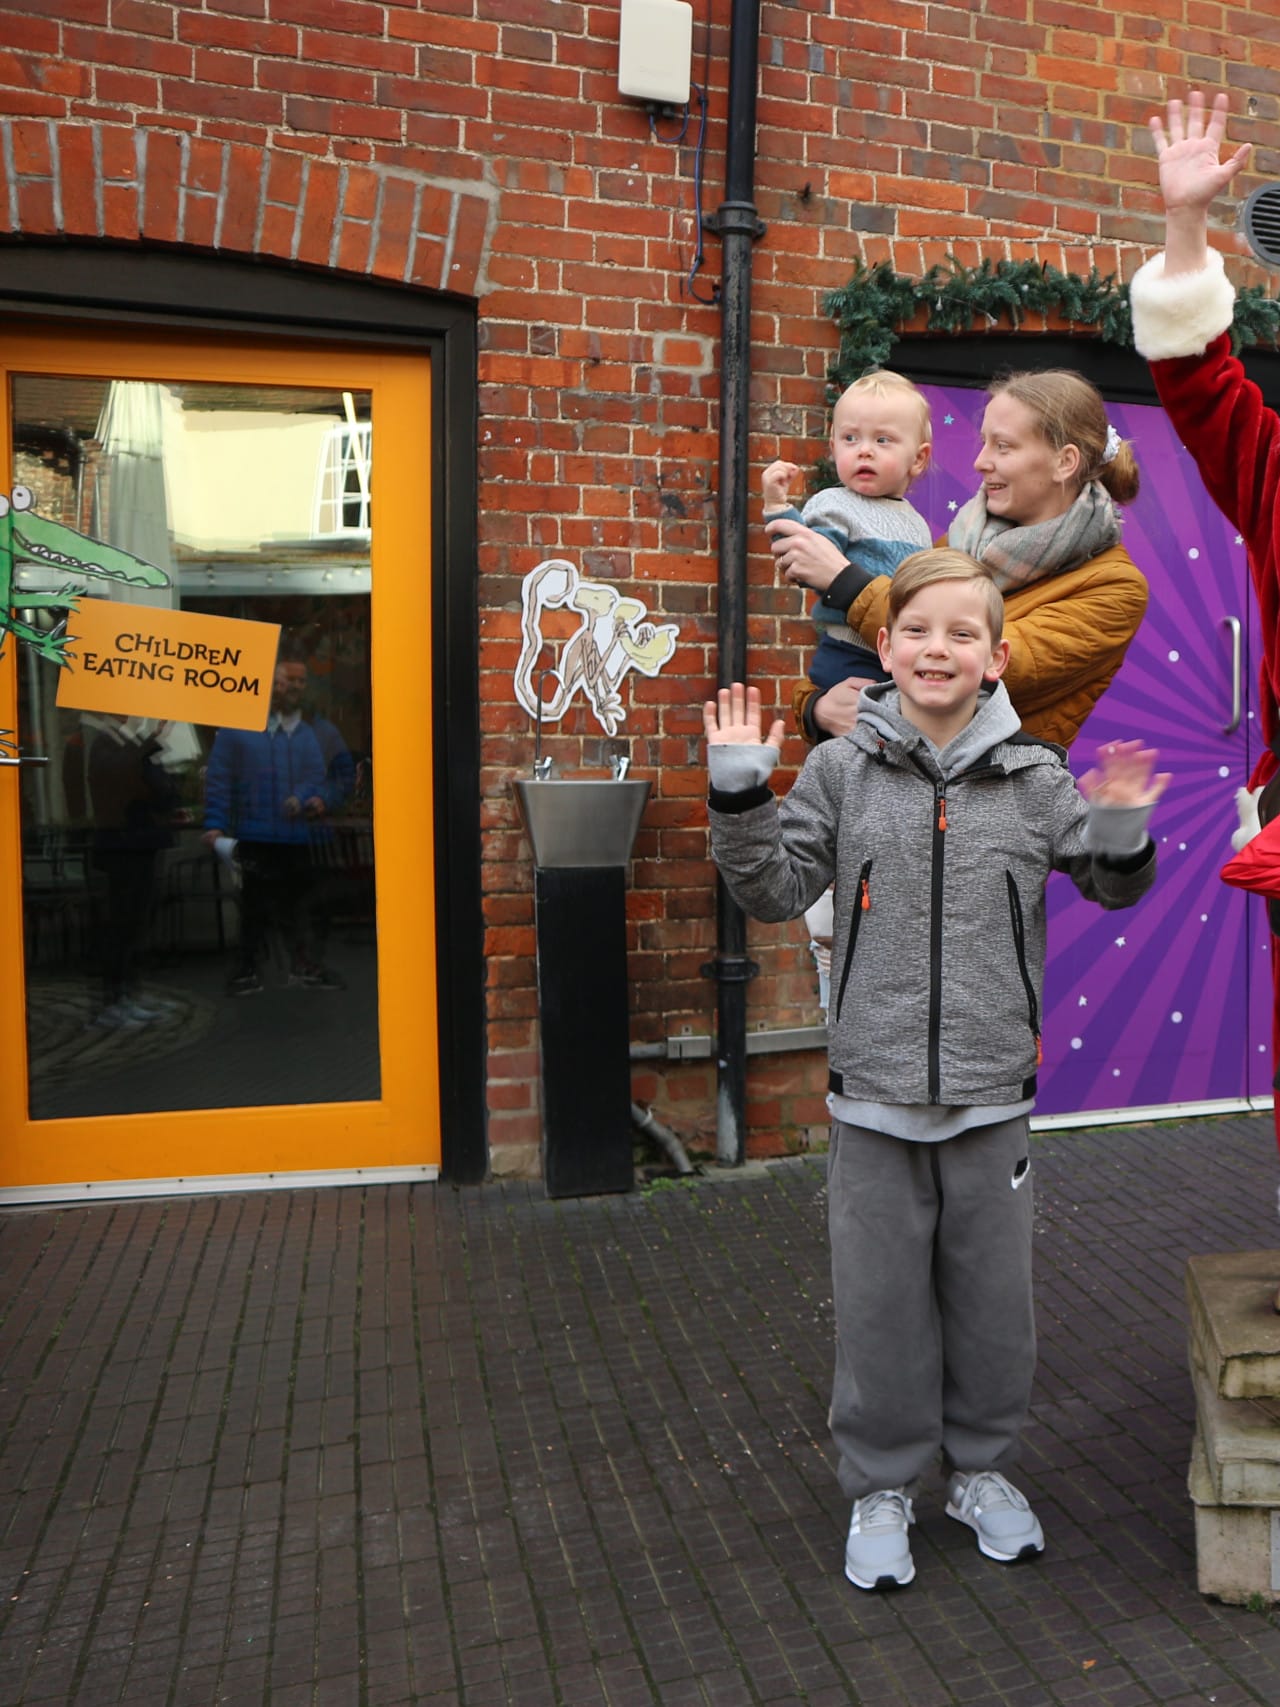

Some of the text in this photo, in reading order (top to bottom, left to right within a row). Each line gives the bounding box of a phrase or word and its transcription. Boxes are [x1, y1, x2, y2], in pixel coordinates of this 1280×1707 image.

[114, 633, 242, 666] CHILDREN
[82, 652, 260, 696] EATING ROOM
